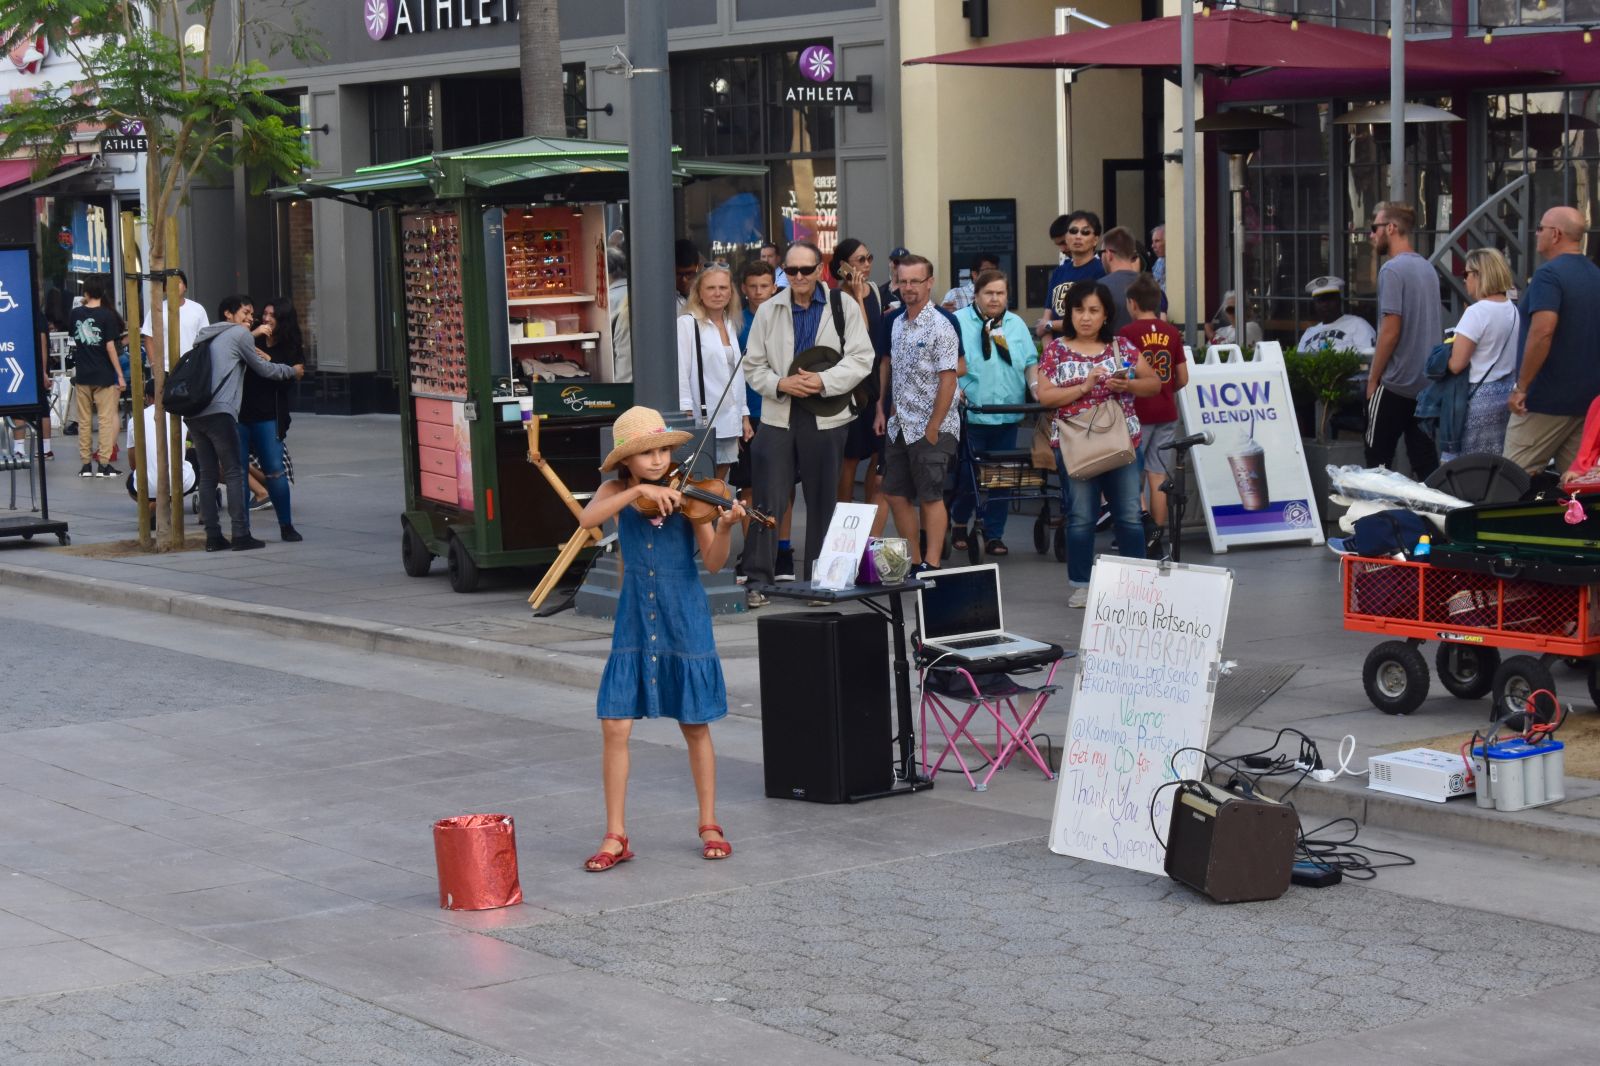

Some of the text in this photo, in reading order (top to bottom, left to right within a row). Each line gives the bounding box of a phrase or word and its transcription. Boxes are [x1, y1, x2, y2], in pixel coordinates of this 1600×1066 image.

[785, 87, 854, 101] ATHLETA
[1141, 332, 1170, 347] JAMES
[1196, 381, 1270, 408] NOW
[1201, 408, 1277, 425] BLENDING
[843, 515, 860, 530] CD
[1095, 591, 1211, 639] Karolina Protsenko
[1069, 739, 1089, 766] Get
[1092, 751, 1107, 777] my
[1070, 769, 1108, 808] Thank
